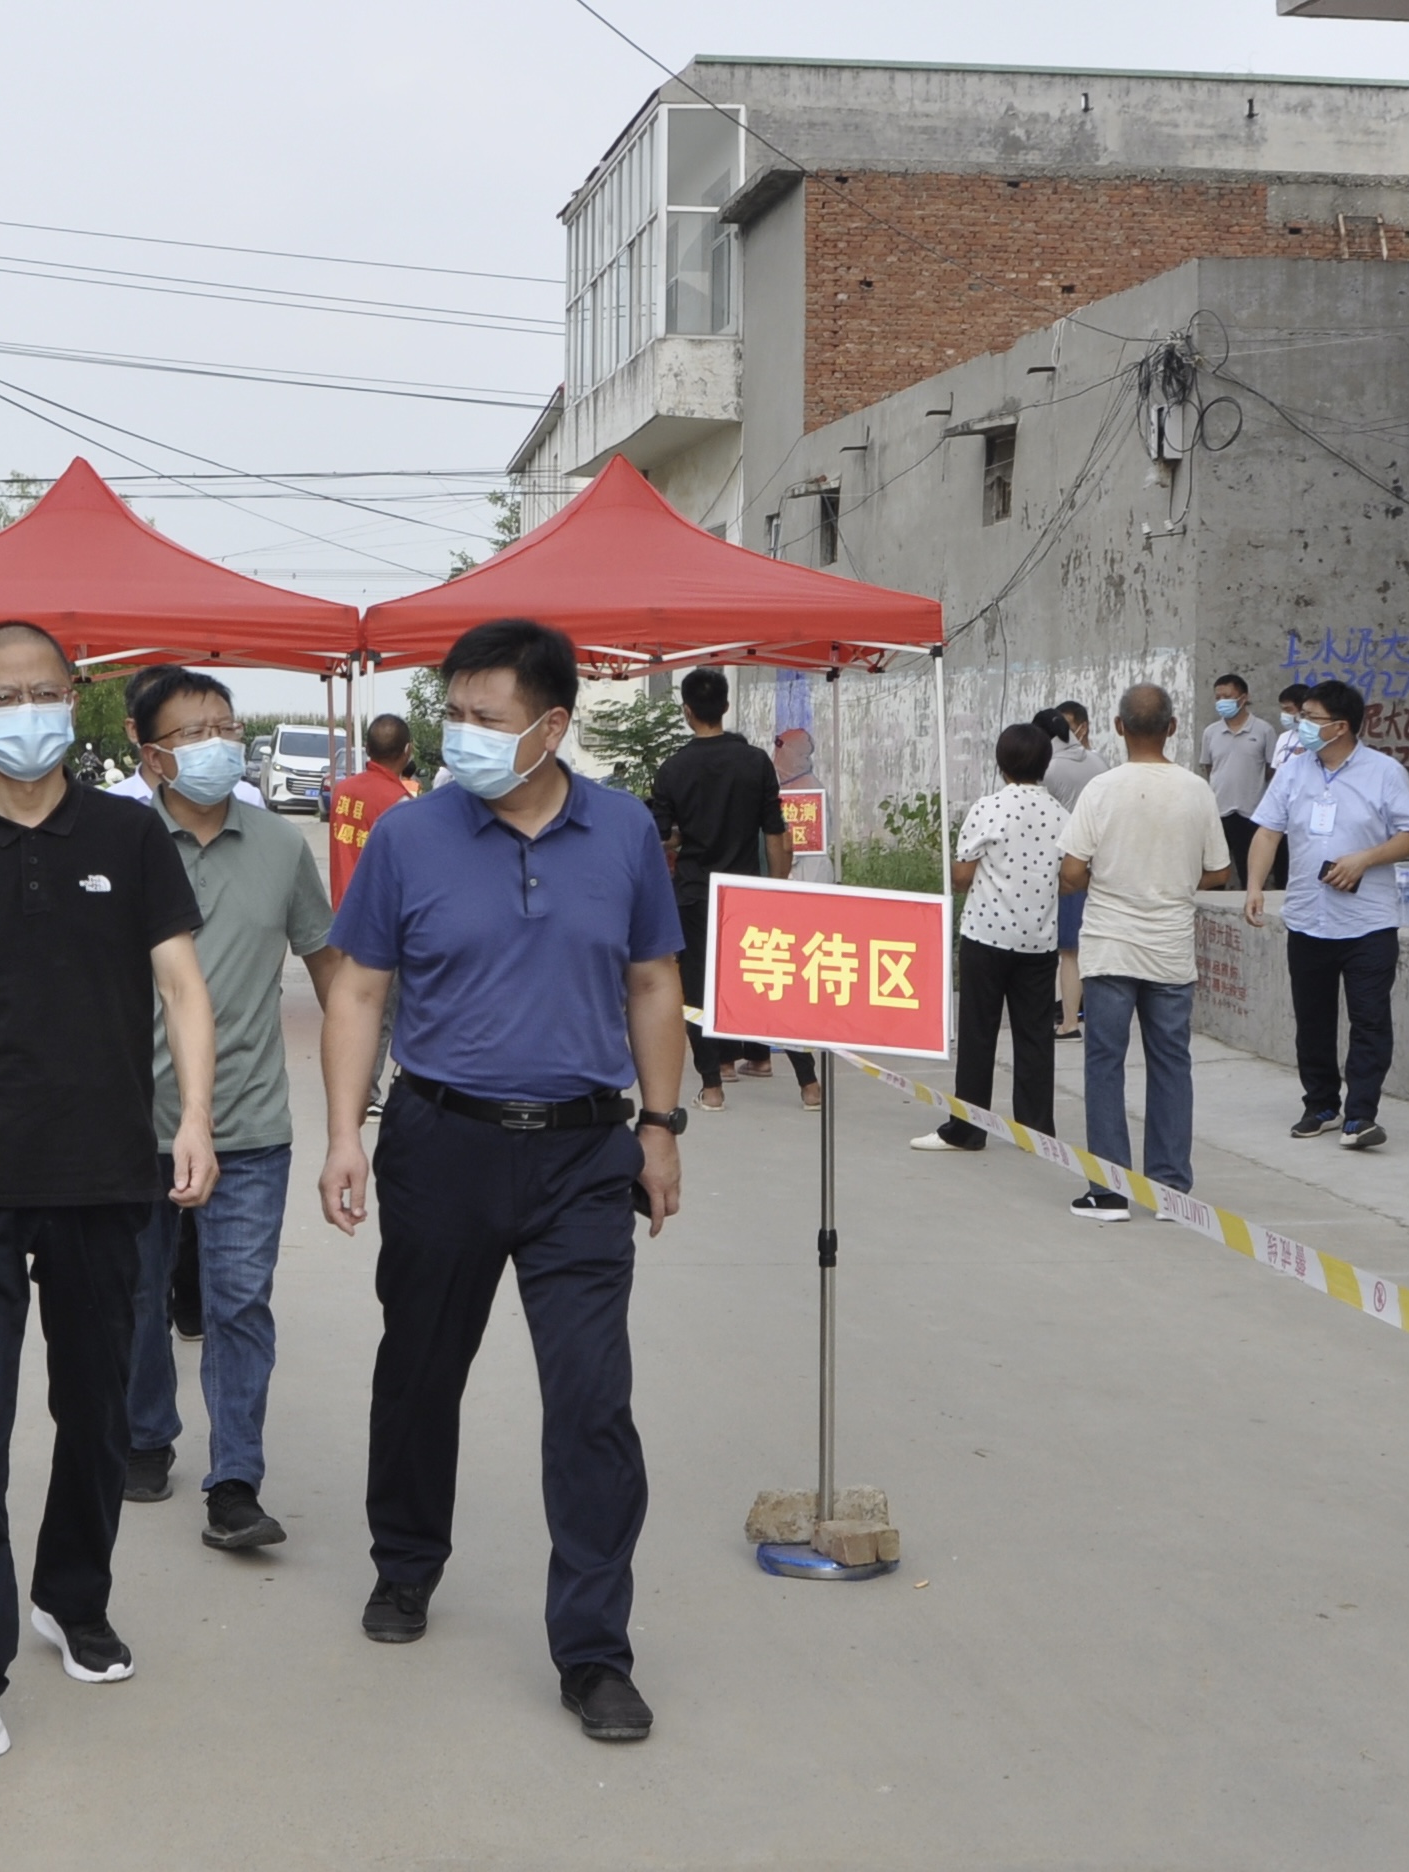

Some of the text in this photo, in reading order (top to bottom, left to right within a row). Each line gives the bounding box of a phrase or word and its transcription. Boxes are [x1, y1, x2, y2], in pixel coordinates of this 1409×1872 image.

[335, 795, 365, 820] 淇县
[333, 822, 370, 849] 愿者
[792, 825, 808, 845] 区
[739, 925, 920, 1010] 等待区
